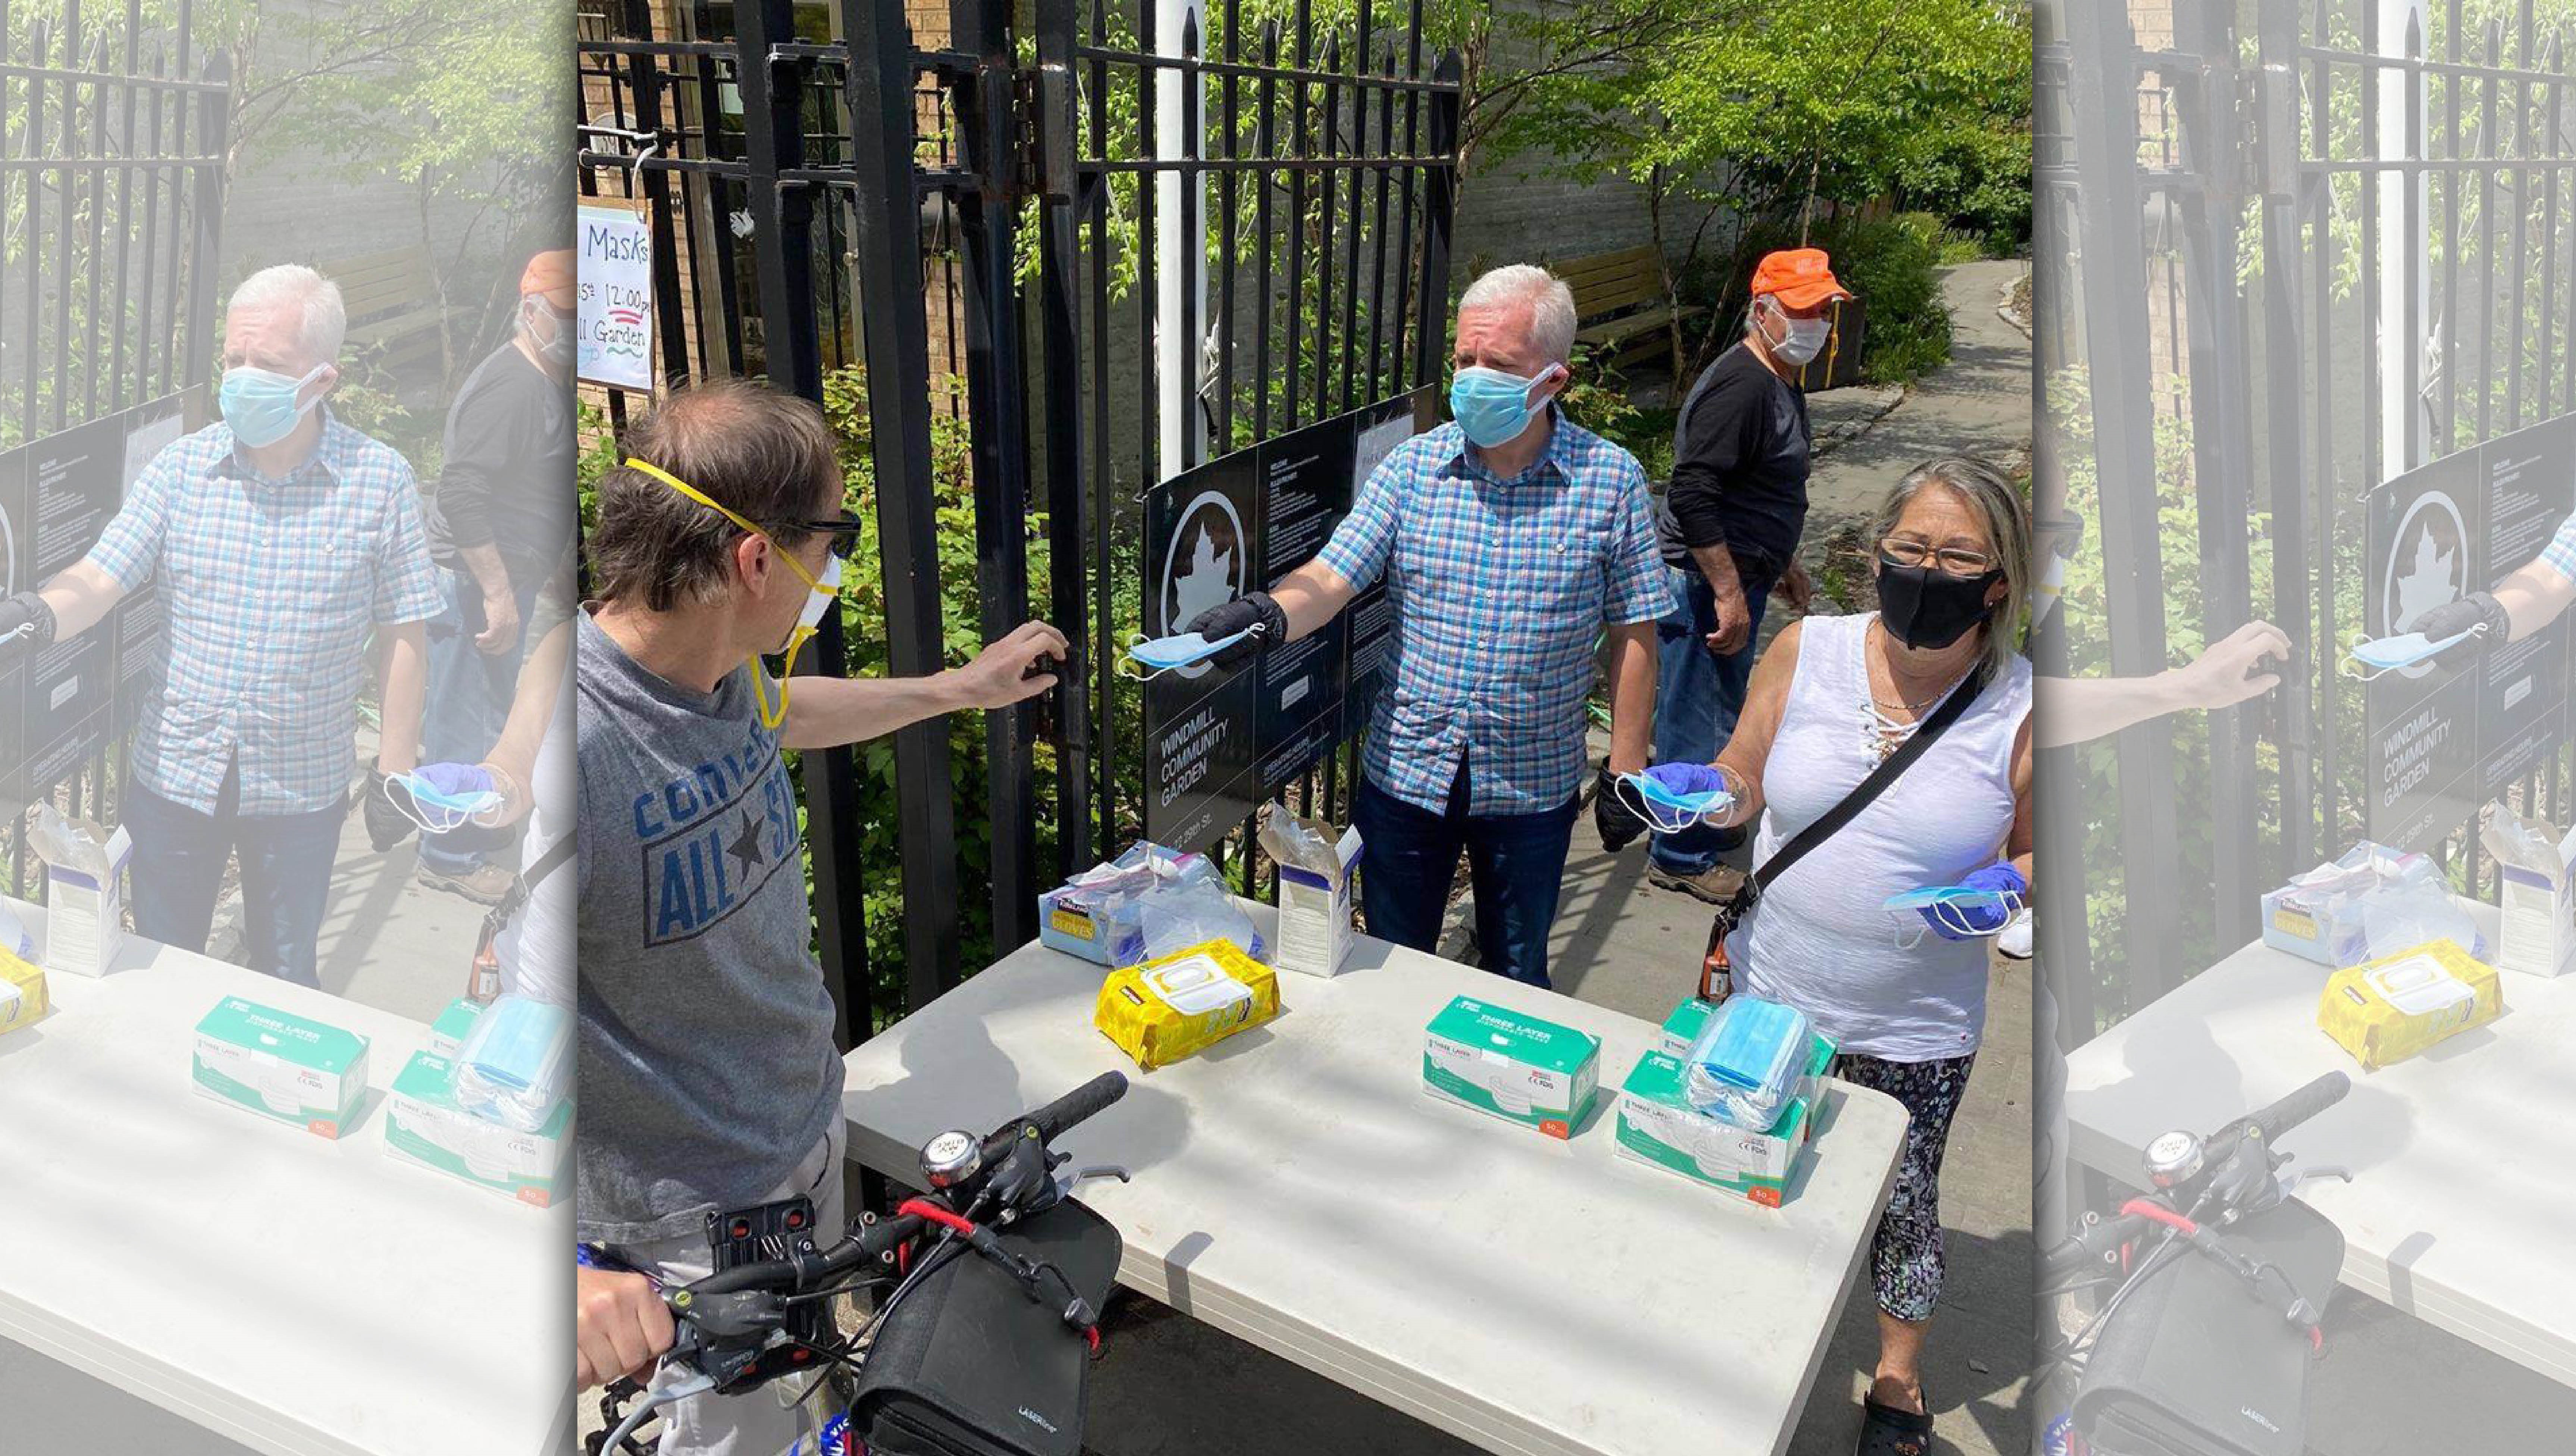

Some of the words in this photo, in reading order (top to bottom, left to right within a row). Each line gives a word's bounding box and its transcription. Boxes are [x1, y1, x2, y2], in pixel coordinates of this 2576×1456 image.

[588, 224, 648, 263] Masks
[593, 320, 645, 346] Garden
[1161, 707, 1215, 758] WINDMILL
[1162, 718, 1229, 783] COMMUNITY
[2384, 707, 2438, 758] WINDMILL
[2385, 718, 2452, 783] COMMUNITY
[1162, 758, 1208, 807] GARDEN
[2385, 758, 2431, 807] GARDEN
[656, 828, 734, 937] ALL
[1480, 1014, 1515, 1028] THREE
[1516, 1025, 1551, 1040] LAYER
